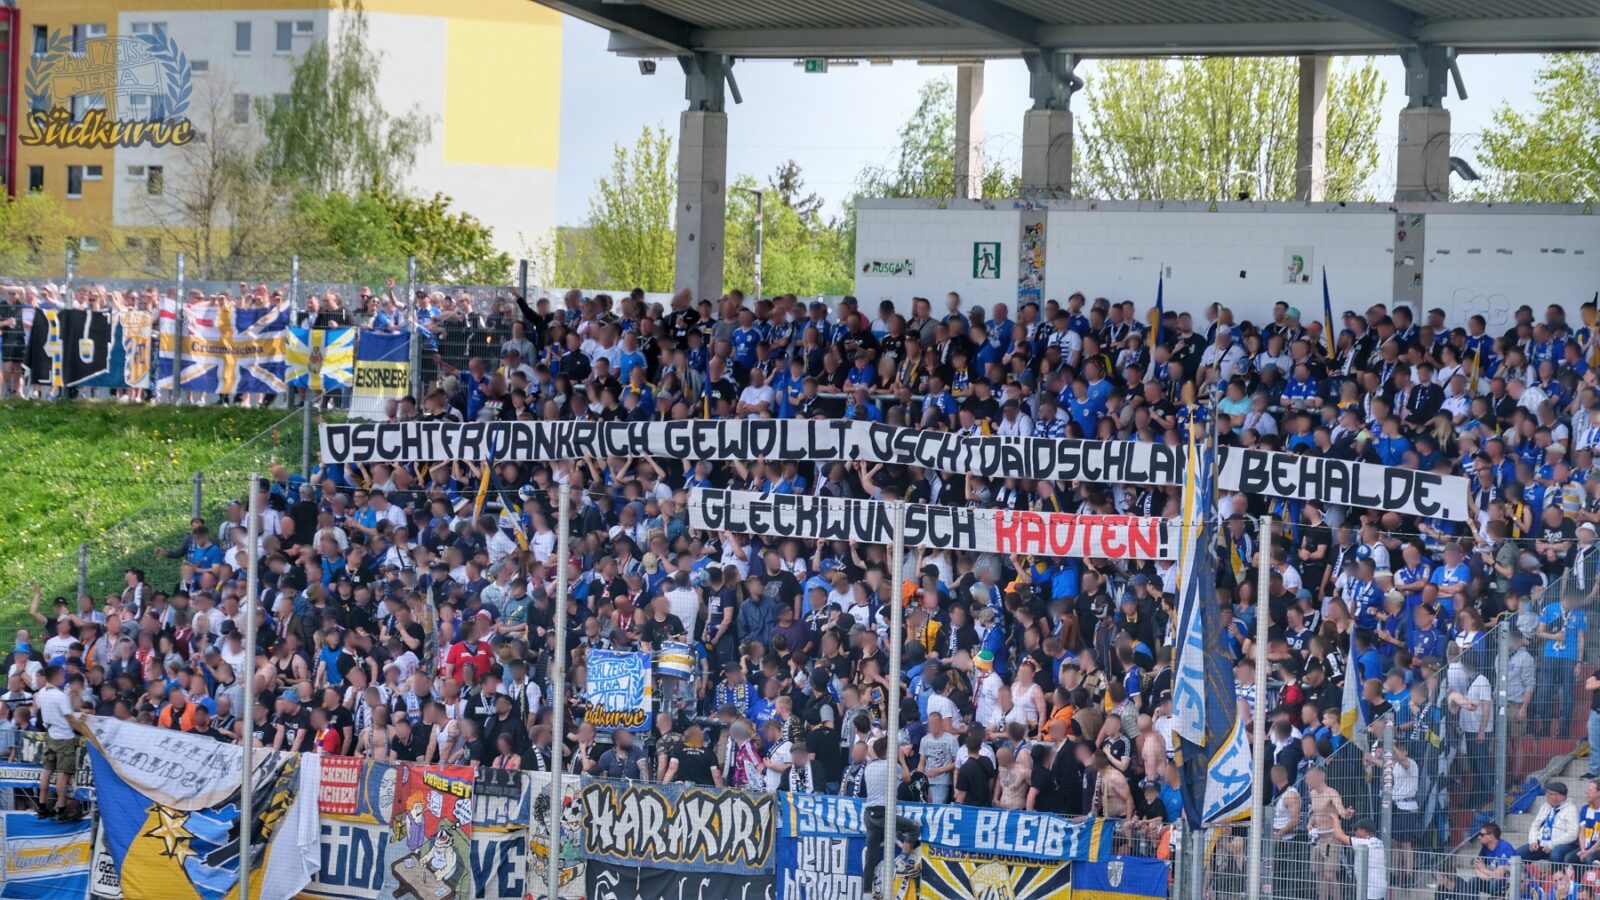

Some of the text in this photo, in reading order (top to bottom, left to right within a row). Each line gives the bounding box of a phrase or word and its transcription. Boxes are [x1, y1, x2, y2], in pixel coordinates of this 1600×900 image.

[1239, 451, 1450, 519] BEHALDE.
[584, 702, 647, 728] üdkurve
[450, 780, 473, 799] EST
[584, 786, 774, 864] HARAKIRI
[974, 809, 1086, 858] BLEIBT
